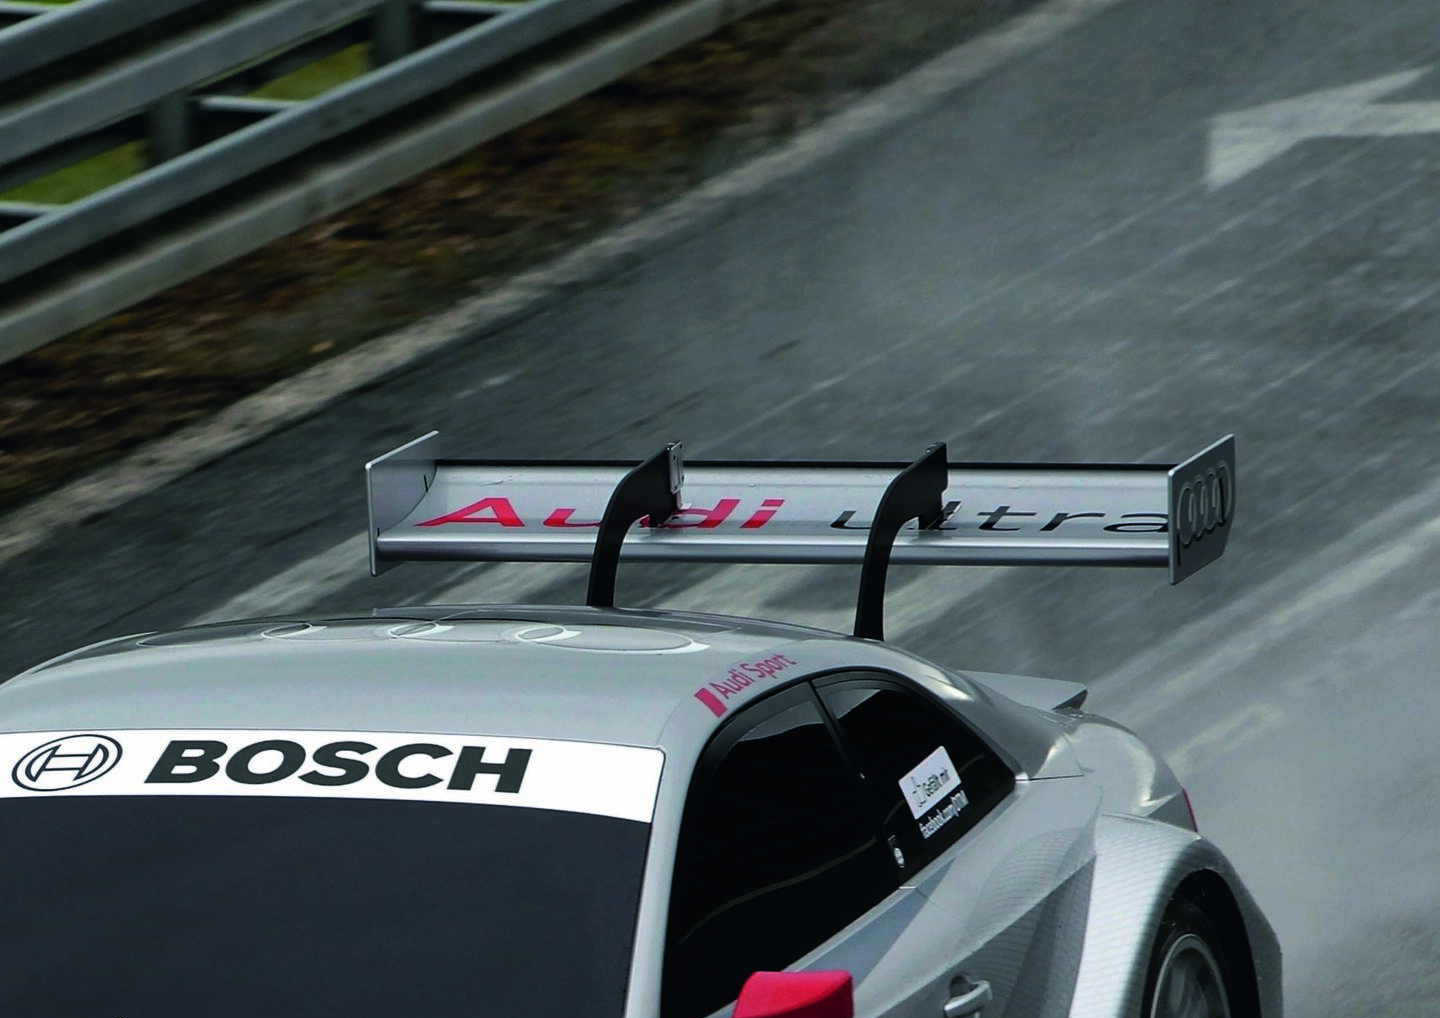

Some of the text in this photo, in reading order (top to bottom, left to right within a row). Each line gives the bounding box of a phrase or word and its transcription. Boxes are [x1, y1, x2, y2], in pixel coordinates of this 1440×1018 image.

[414, 497, 785, 529] Audi
[709, 653, 797, 699] Audi Sport
[143, 739, 534, 794] BOSCH
